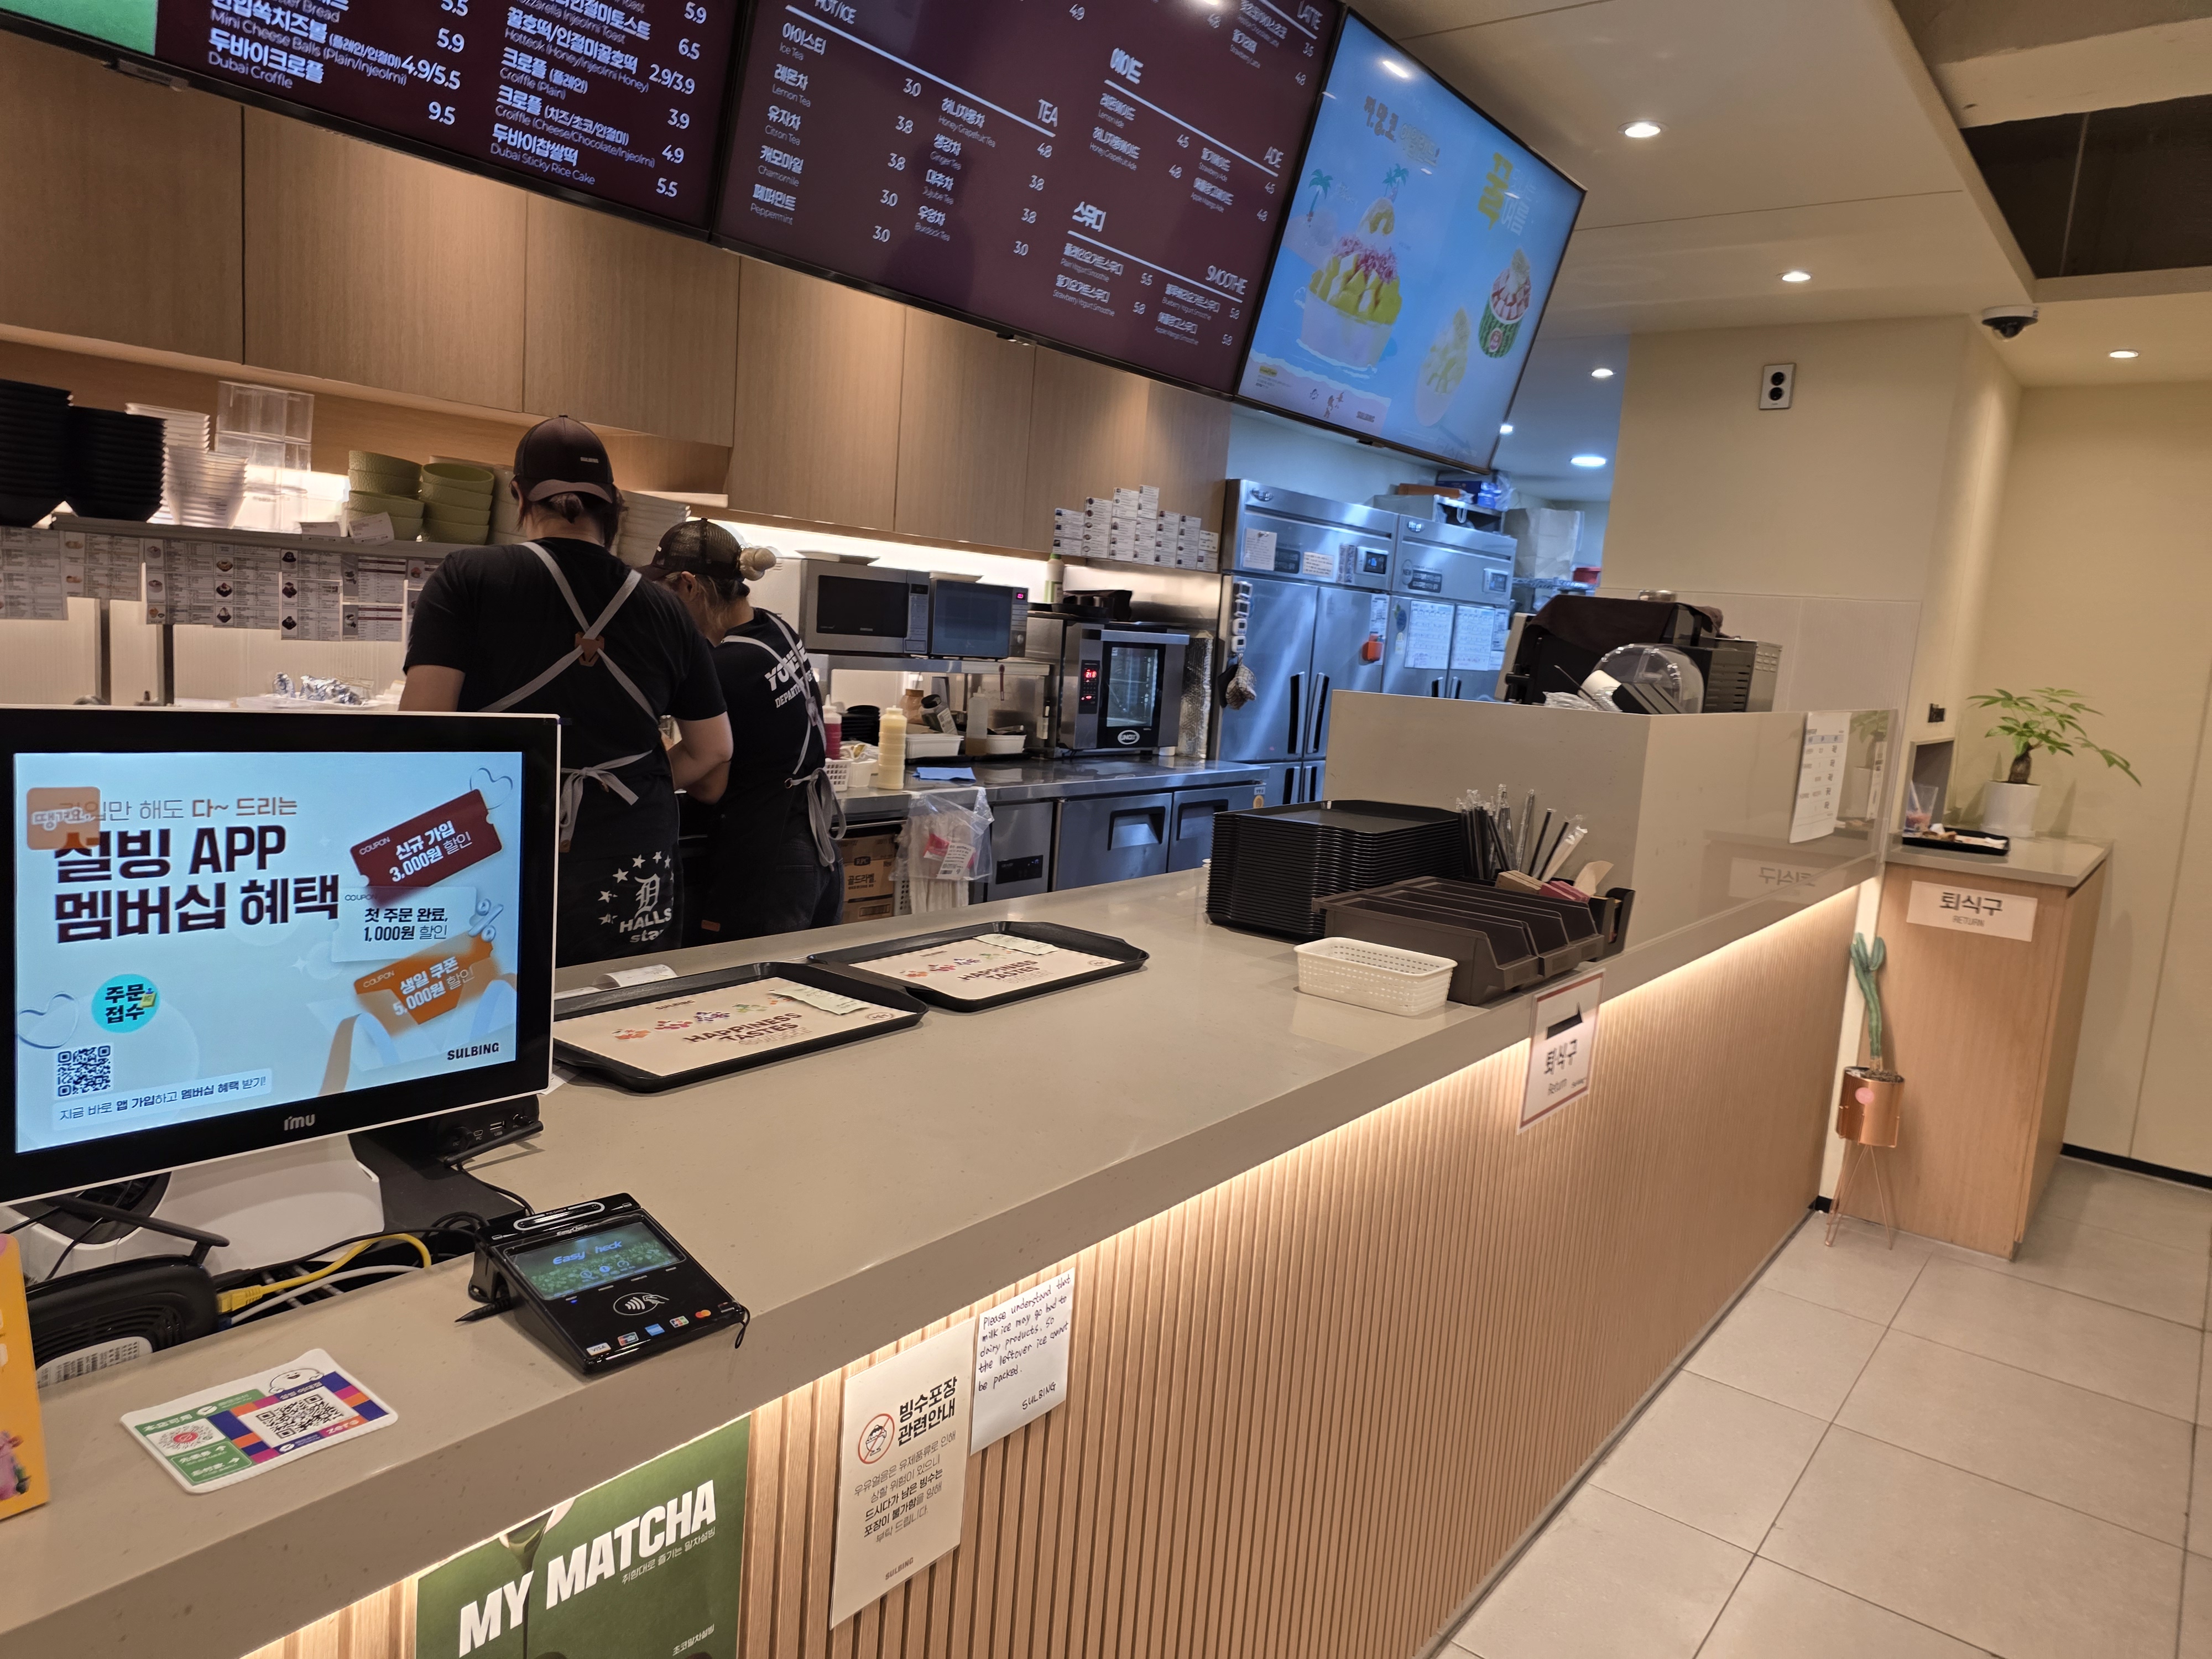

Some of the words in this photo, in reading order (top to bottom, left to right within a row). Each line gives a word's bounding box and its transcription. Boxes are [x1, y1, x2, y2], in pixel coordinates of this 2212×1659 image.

[684, 2, 707, 24] 5.9
[210, 8, 241, 29] Mini
[242, 19, 291, 47] Cheese
[291, 36, 321, 58] Balls
[436, 28, 465, 53] 5.9
[782, 22, 826, 55] 아이스티
[208, 27, 324, 84] 두바이크로플
[501, 46, 547, 80] 크로플
[679, 38, 701, 60] 6.5
[780, 42, 791, 55] Ice
[208, 51, 249, 75] Dubai
[251, 65, 293, 89] Croffle
[401, 55, 461, 90] 4.9/5.5
[649, 64, 695, 95] 2.9/3.9
[774, 64, 808, 91] 레몬차
[497, 84, 542, 116] 크로플
[772, 84, 797, 102] Lemon
[798, 95, 811, 107] Tea
[428, 101, 455, 125] 9.5
[667, 108, 690, 129] 3.9
[768, 105, 801, 131] 유자차
[1037, 98, 1058, 127] TEA
[492, 123, 578, 167] 두바이찹쌀떡
[661, 144, 684, 164] 4.9
[760, 145, 804, 174] 캐모마일
[490, 143, 520, 161] Dubai
[521, 153, 550, 173] Sticky
[551, 162, 571, 178] Rice
[572, 169, 595, 185] Cake
[758, 165, 800, 187] Chamomile
[655, 177, 678, 197] 5.5
[750, 202, 792, 225] Peppermint
[1072, 201, 1106, 232] 스무디
[139, 799, 184, 820] 해도
[236, 796, 298, 817] 드리는
[54, 828, 171, 884] 설빙
[189, 825, 286, 875] APP
[359, 836, 390, 855] COUPON
[395, 834, 425, 860] 신규
[425, 820, 456, 846] 가입
[389, 848, 444, 882] 3,000원
[444, 831, 472, 855] 할인
[54, 882, 226, 944] 멤버십
[240, 874, 340, 926] 혜택
[364, 908, 380, 923] 첫
[383, 908, 413, 923] 주문
[417, 908, 448, 922] 완료,
[1939, 892, 2003, 916] 퇴식구
[364, 926, 415, 942] 1,000원
[419, 925, 447, 940] 할인
[619, 907, 671, 933] HALLS
[363, 970, 395, 988] COUPON
[399, 971, 427, 995] 생일
[430, 956, 459, 979] 쿠폰
[447, 967, 475, 990] 할인
[957, 960, 1039, 981] HAPPINESS
[985, 967, 1040, 980] TASTES
[105, 983, 144, 1003] 주문
[105, 1004, 145, 1024] 접수
[682, 1013, 802, 1042] HAPPINESS
[719, 1023, 799, 1041] TASTES
[447, 1042, 499, 1060] SULBING
[1544, 1039, 1577, 1074] 퇴식구
[59, 1107, 84, 1121] 지금
[88, 1102, 113, 1117] 바로
[116, 1099, 128, 1112] 앱
[131, 1092, 178, 1110] 가입하고
[181, 1084, 215, 1100] 멤버십
[217, 1079, 239, 1094] 혜택
[242, 1076, 267, 1089] 받기!
[553, 1251, 586, 1265] Easy
[591, 1241, 622, 1254] heck
[982, 1328, 998, 1343] milk
[1000, 1324, 1011, 1335] ice
[1016, 1313, 1031, 1327] may
[1034, 1308, 1042, 1321] go
[1058, 1295, 1067, 1305] to
[983, 1311, 1006, 1330] Please
[1011, 1285, 1051, 1314] understand
[978, 1359, 993, 1373] the
[999, 1343, 1032, 1366] leftover
[1036, 1334, 1047, 1348] ice
[980, 1343, 1000, 1358] dairy
[978, 1380, 987, 1391] be
[993, 1364, 1022, 1389] packed.
[899, 1376, 957, 1423] 빙수포장
[1022, 1381, 1056, 1411] SULBING
[326, 1420, 359, 1434] zero
[898, 1398, 955, 1447] 관련안내
[854, 1465, 896, 1496] 우유얼음은
[941, 1430, 956, 1448] 인해
[871, 1485, 888, 1503] 상할
[890, 1469, 914, 1491] 위험이
[917, 1454, 940, 1477] 있으니
[864, 1513, 890, 1538] 포장이
[892, 1493, 924, 1520] 불가함을
[926, 1481, 942, 1499] 양해
[865, 1493, 899, 1522] 드시다가
[901, 1482, 917, 1500] 남은
[920, 1469, 943, 1488] 빙수는
[876, 1526, 893, 1542] 부탁
[459, 1569, 535, 1658] MY
[546, 1479, 716, 1610] MATCHA
[622, 1559, 655, 1584] 취향대로
[658, 1547, 682, 1566] 즐기는
[685, 1526, 715, 1552] 말차설빙
[885, 1557, 914, 1580] SULBING
[672, 1624, 714, 1656] 초코말차설빙
